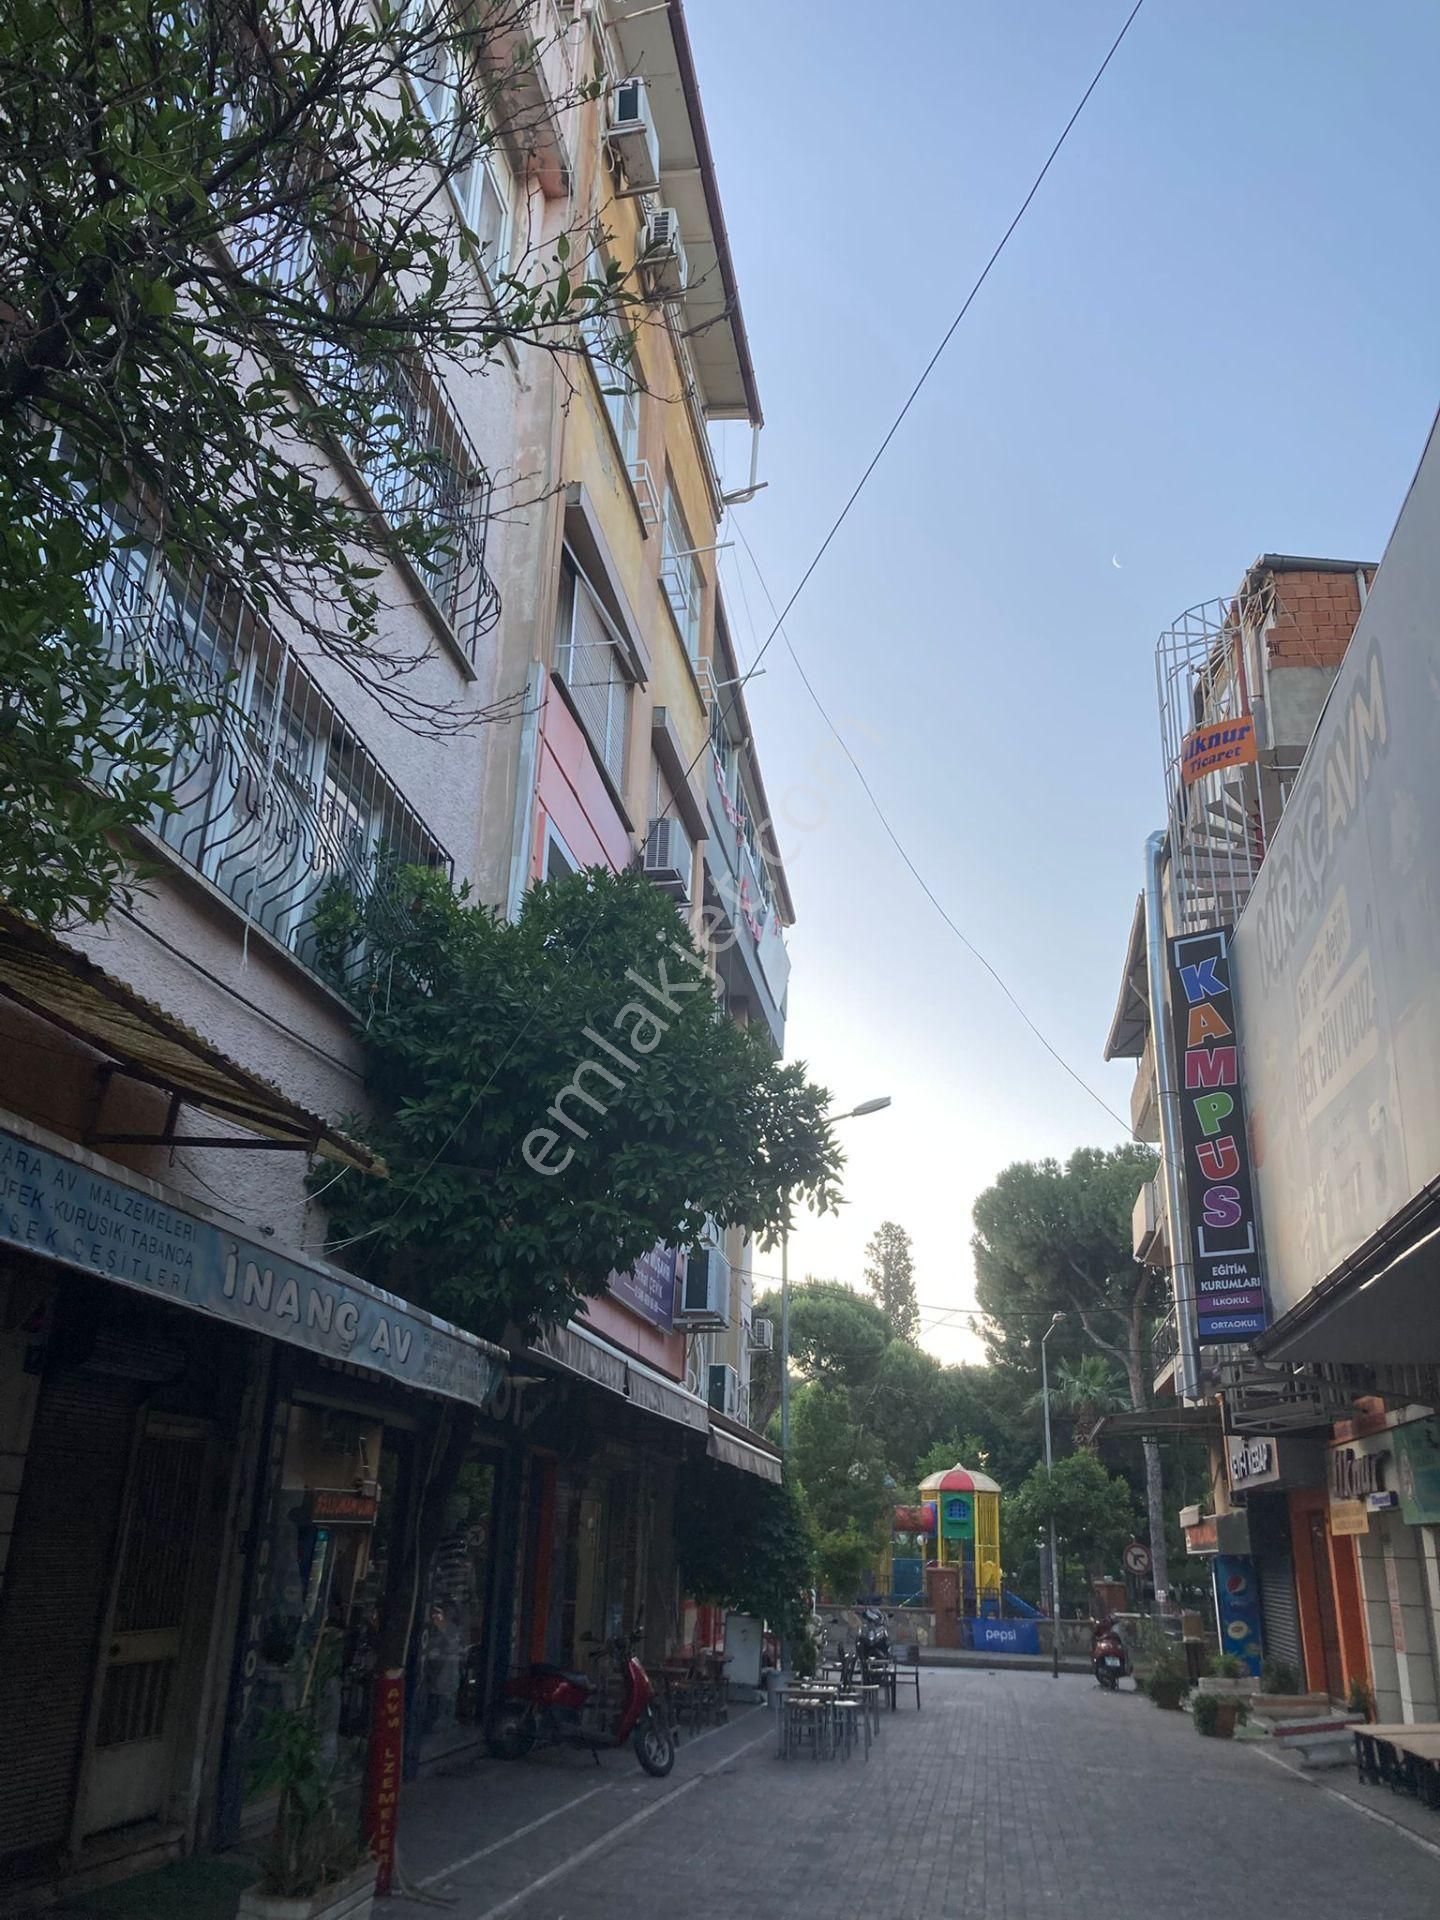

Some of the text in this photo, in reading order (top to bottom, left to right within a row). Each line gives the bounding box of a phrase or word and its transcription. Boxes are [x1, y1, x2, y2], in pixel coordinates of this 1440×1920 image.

[1190, 746, 1242, 774] Ticaret
[1323, 644, 1391, 866] AVM
[1178, 955, 1243, 1229] KAMPÜS
[0, 1143, 42, 1177] ARA
[53, 1168, 78, 1192] AV
[131, 1228, 193, 1269] TABANCA
[1212, 1262, 1247, 1277] EĞİTİM
[1201, 1277, 1261, 1292] KURUMLARI
[223, 1242, 412, 1364] İNANÇ AV
[1212, 1295, 1251, 1307] İLKOKUL
[1210, 1319, 1258, 1330] ORTAOKUL
[985, 1628, 1017, 1643] pepsi
